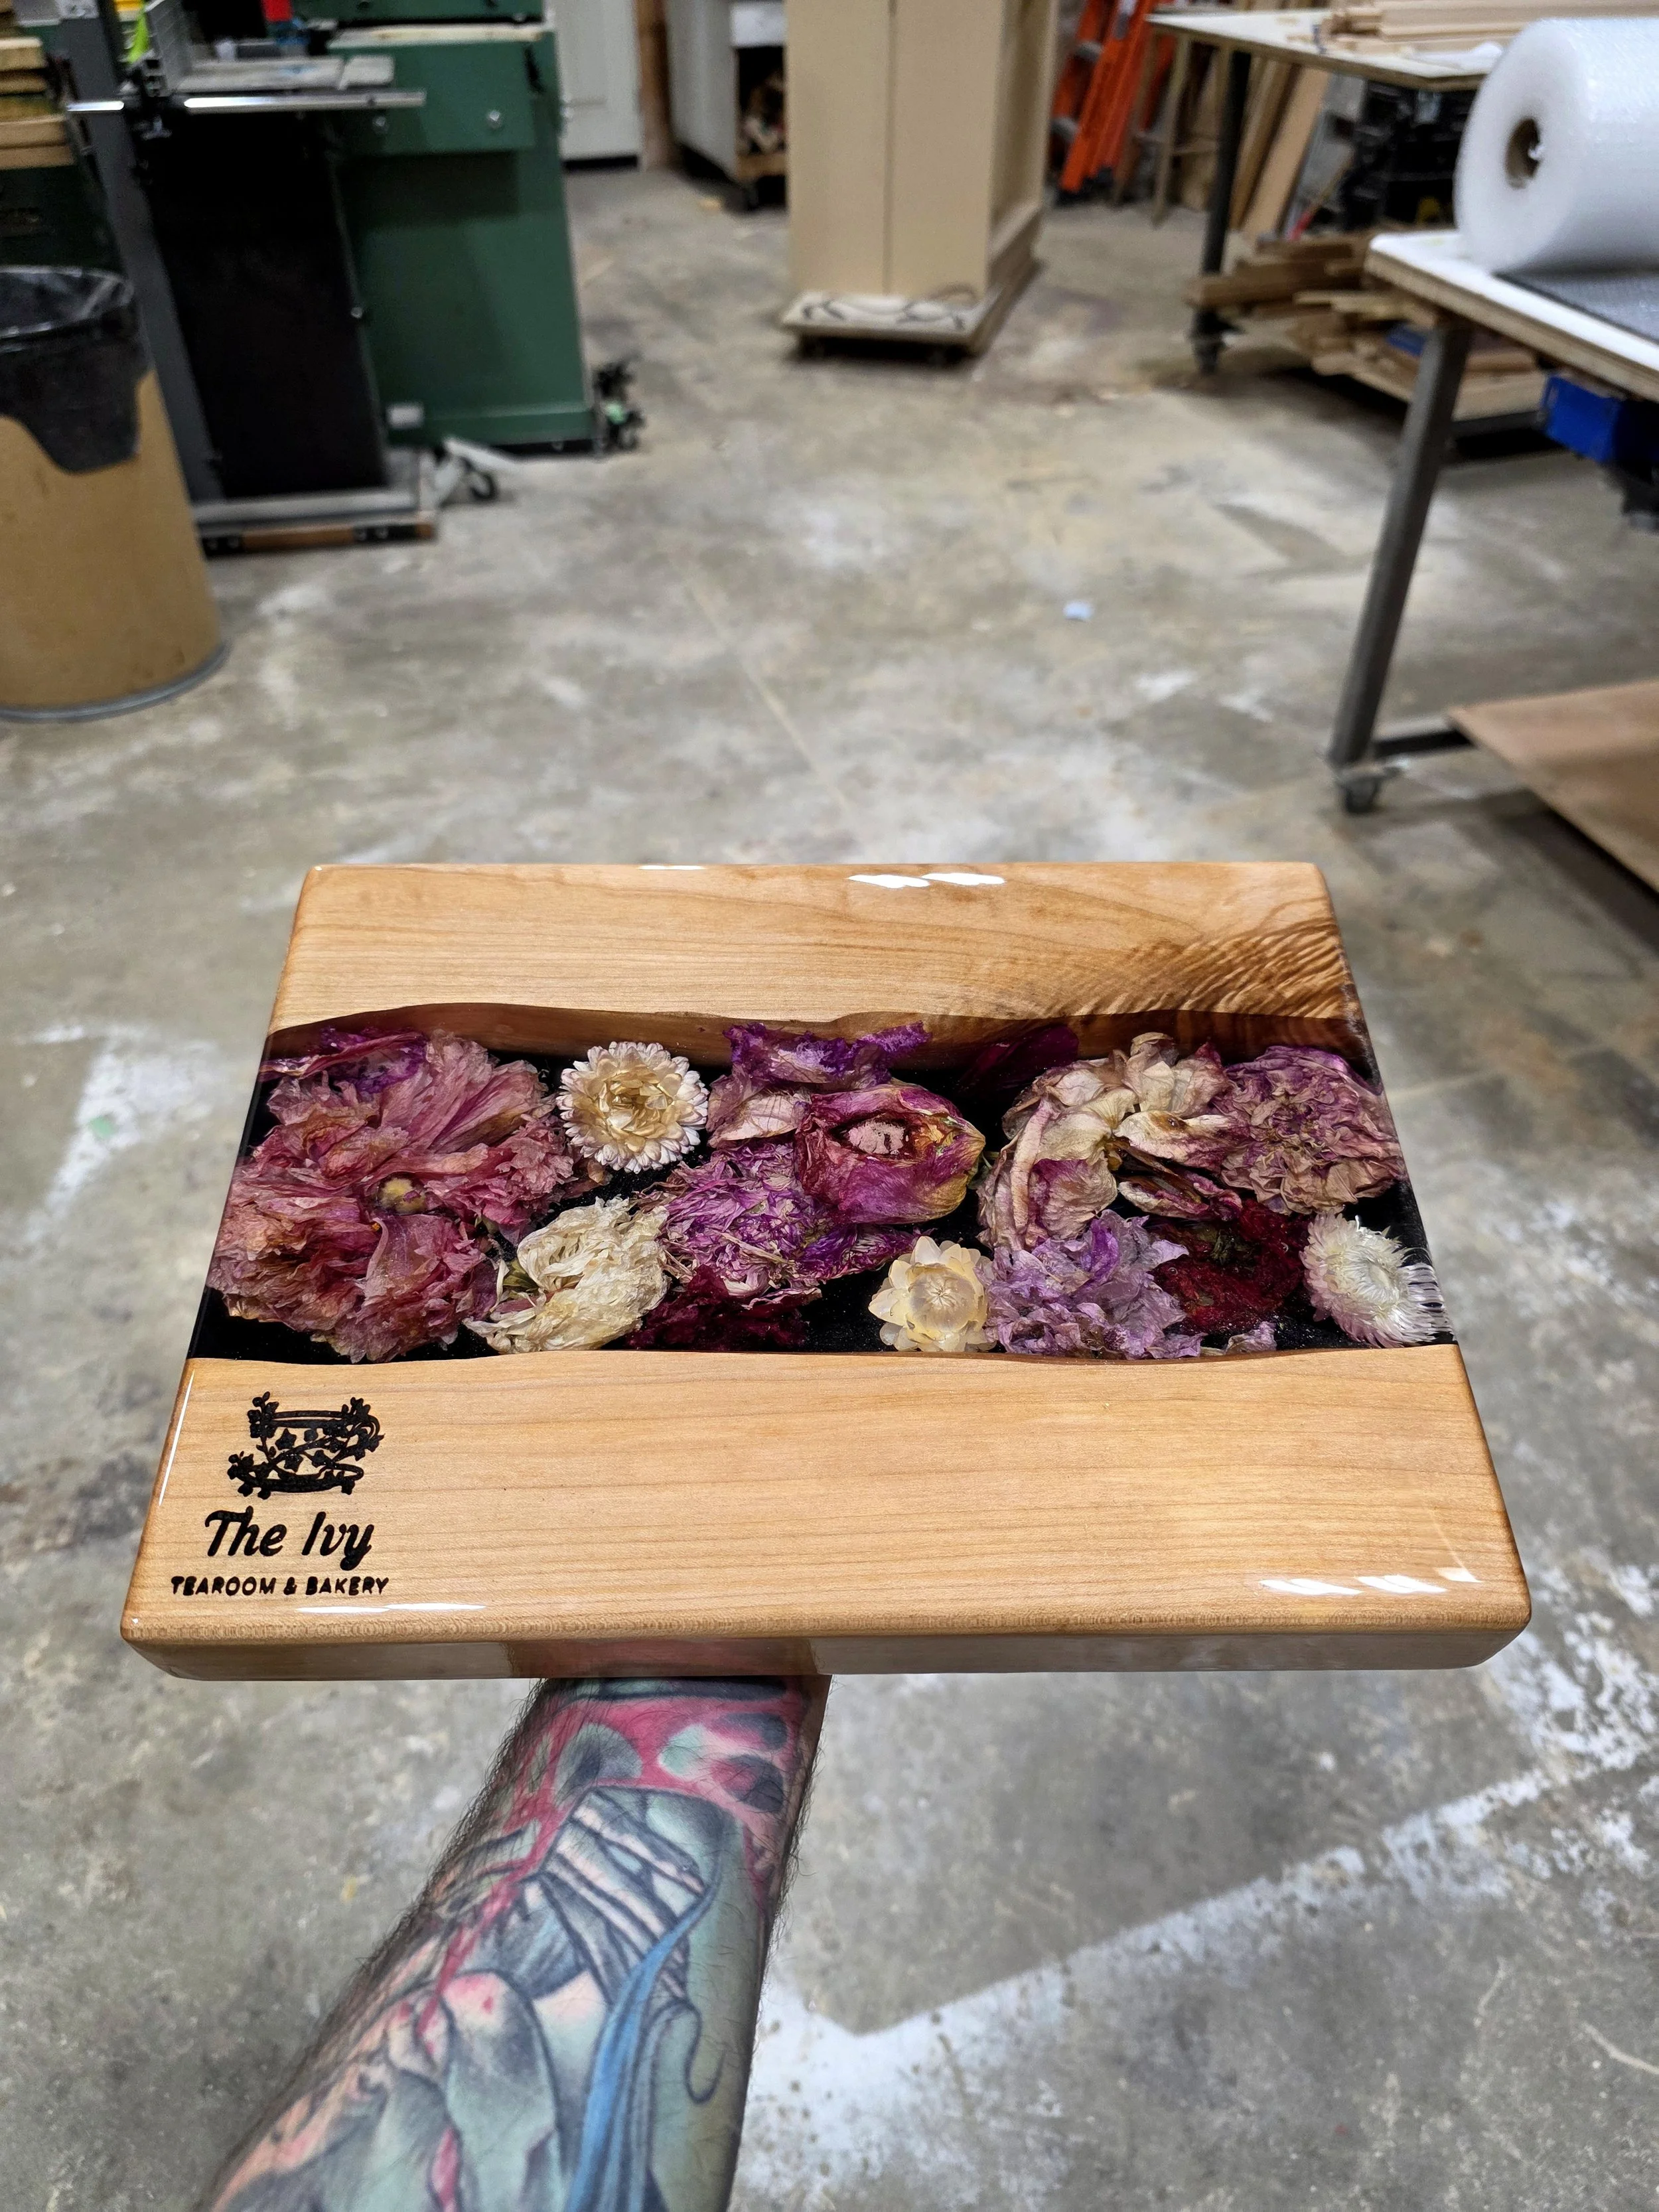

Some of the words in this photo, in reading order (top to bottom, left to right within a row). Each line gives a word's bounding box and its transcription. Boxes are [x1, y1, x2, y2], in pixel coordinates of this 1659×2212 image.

[204, 1505, 287, 1557] The
[301, 1511, 374, 1571] Ivy
[171, 1576, 277, 1596] TEAROOM
[283, 1576, 297, 1595] &
[305, 1576, 390, 1596] BAKERY
